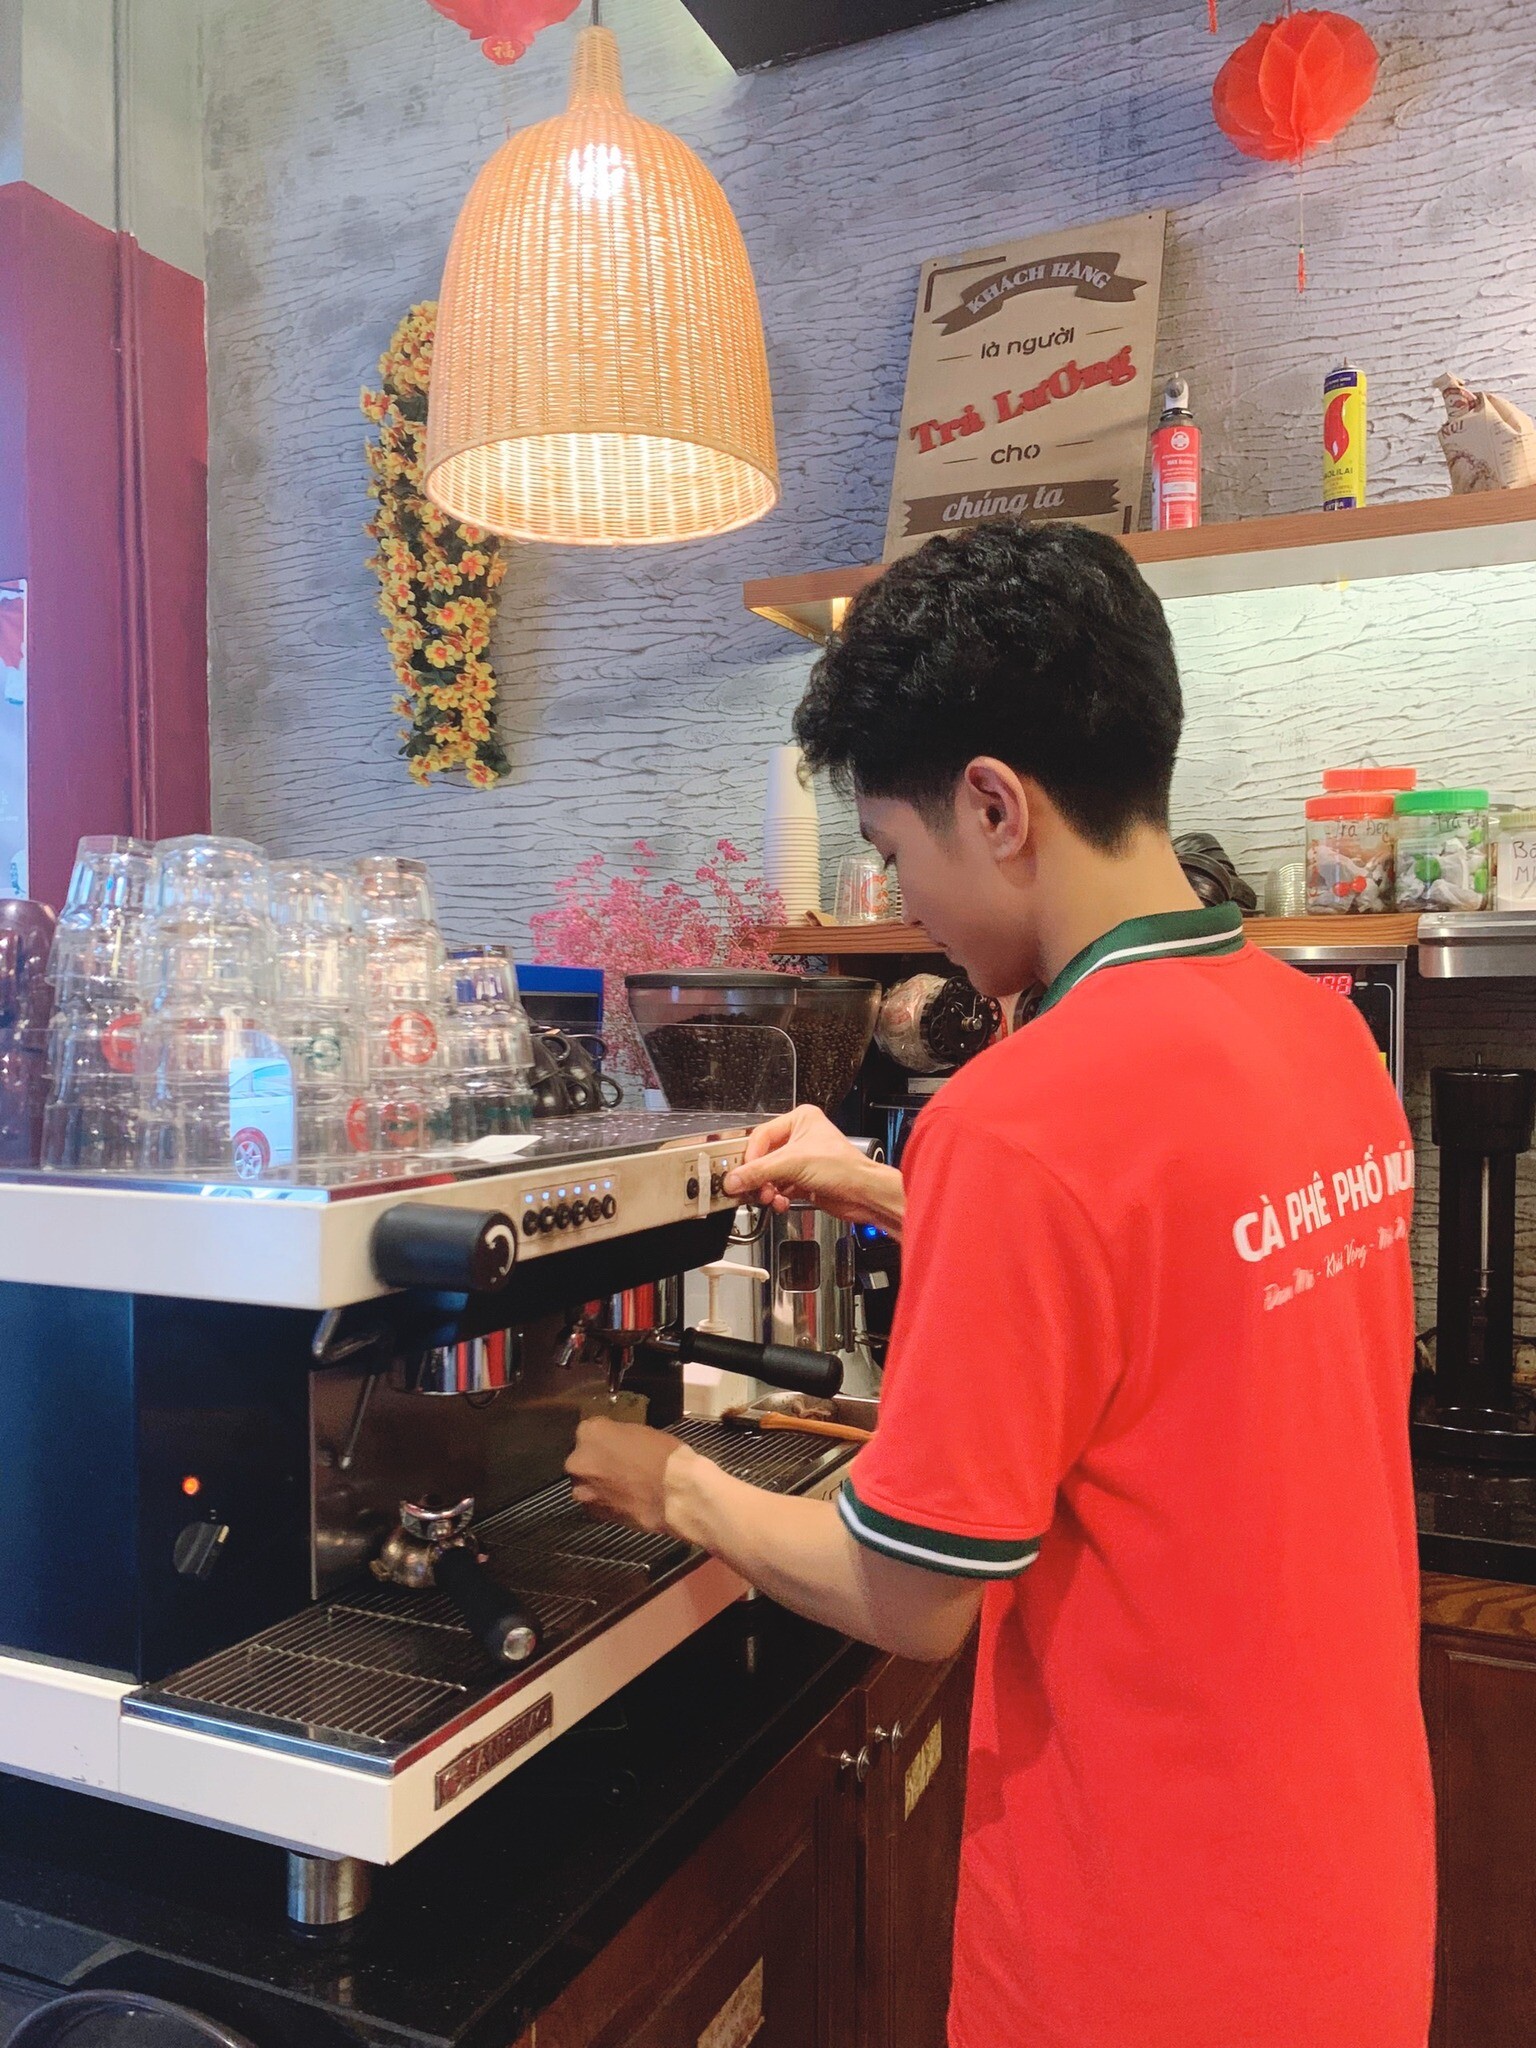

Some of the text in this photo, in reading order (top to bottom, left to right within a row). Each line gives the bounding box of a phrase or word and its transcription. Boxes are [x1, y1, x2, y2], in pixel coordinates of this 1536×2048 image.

[965, 259, 1111, 315] KHÁCH HÀNG
[981, 341, 1000, 360] là
[990, 443, 1041, 465] cho
[1032, 485, 1065, 509] ta
[1232, 1194, 1286, 1262] CÀ
[1285, 1171, 1332, 1241] PHÊ
[1332, 1144, 1383, 1217] PHỐ
